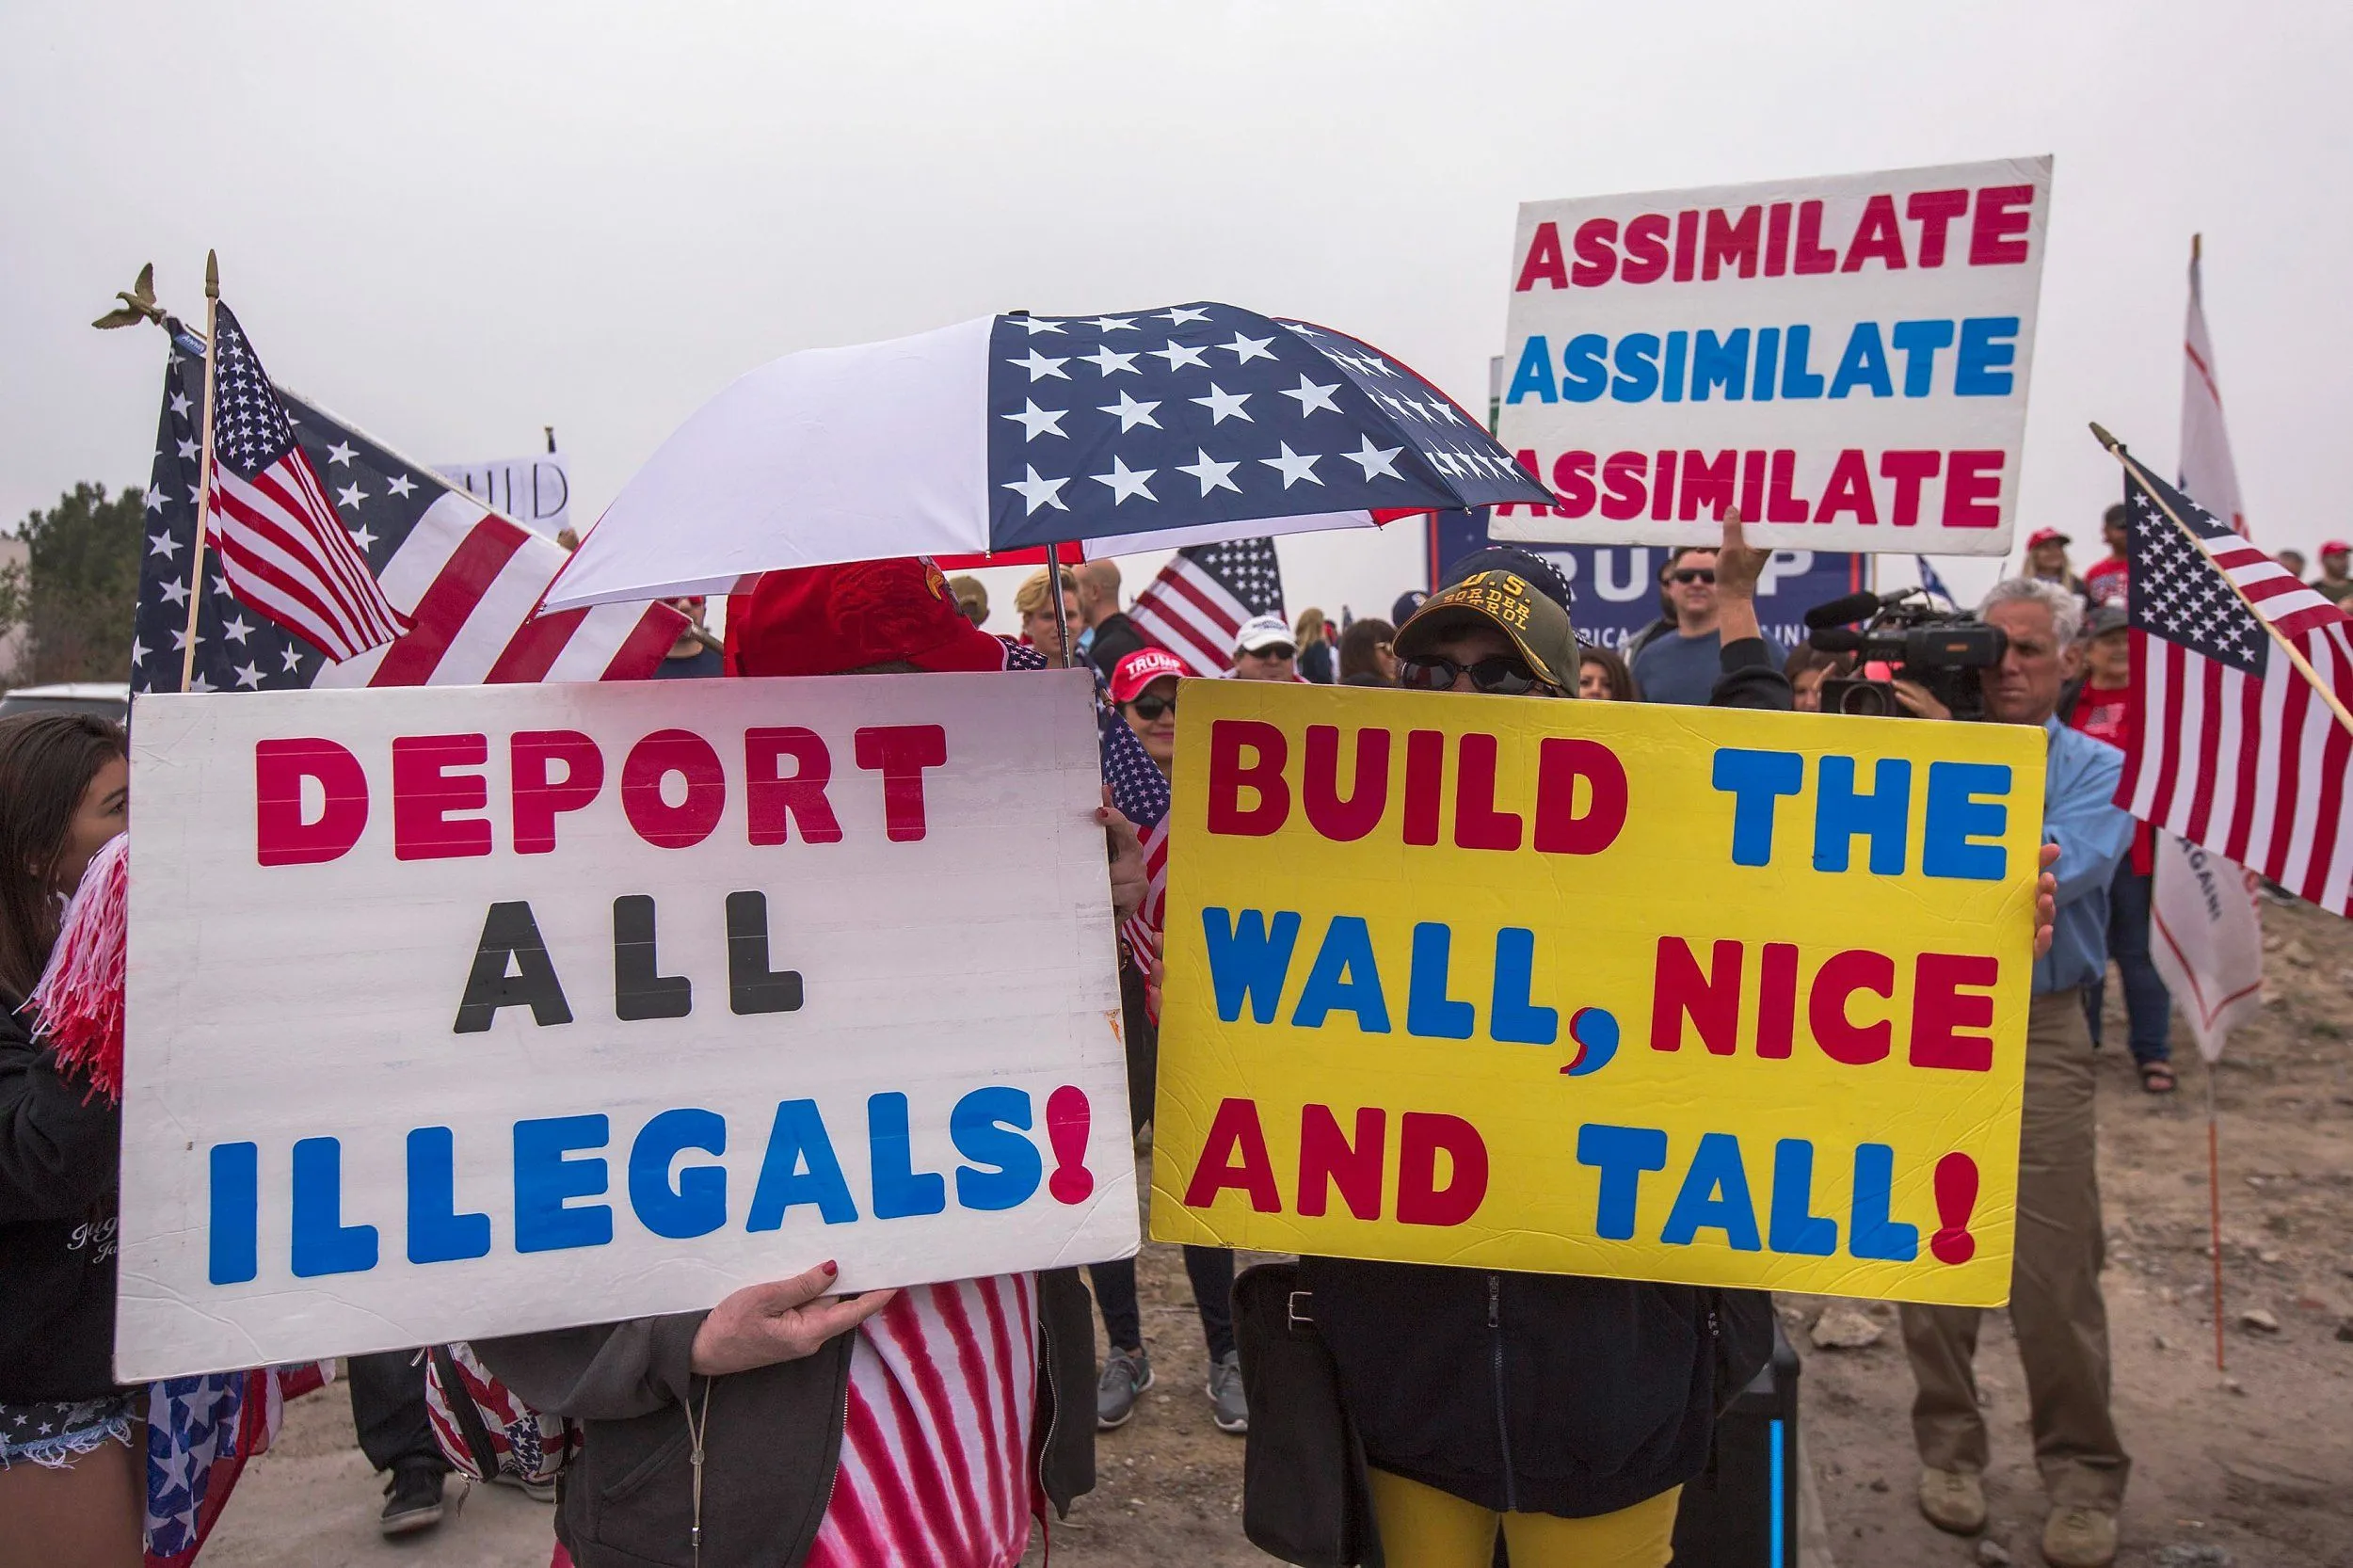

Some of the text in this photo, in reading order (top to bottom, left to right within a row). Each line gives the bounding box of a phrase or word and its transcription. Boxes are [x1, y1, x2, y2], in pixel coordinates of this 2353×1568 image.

[1516, 184, 2034, 292] ASSIMILATE
[1505, 316, 2019, 405] ASSIMILATE
[1495, 449, 2005, 528] ASSIMILATE
[1444, 579, 1529, 619] BORDER
[1461, 570, 1531, 604] U.S.
[1126, 653, 1181, 674] TRUMP
[255, 724, 948, 867] DEPORT
[1209, 721, 2011, 881] BUILD THE
[453, 890, 805, 1034] ALL
[1203, 908, 1999, 1078] WALL, NICE
[209, 1085, 1094, 1286] ILLEGALS!
[1184, 1097, 1979, 1266] AND TALL!
